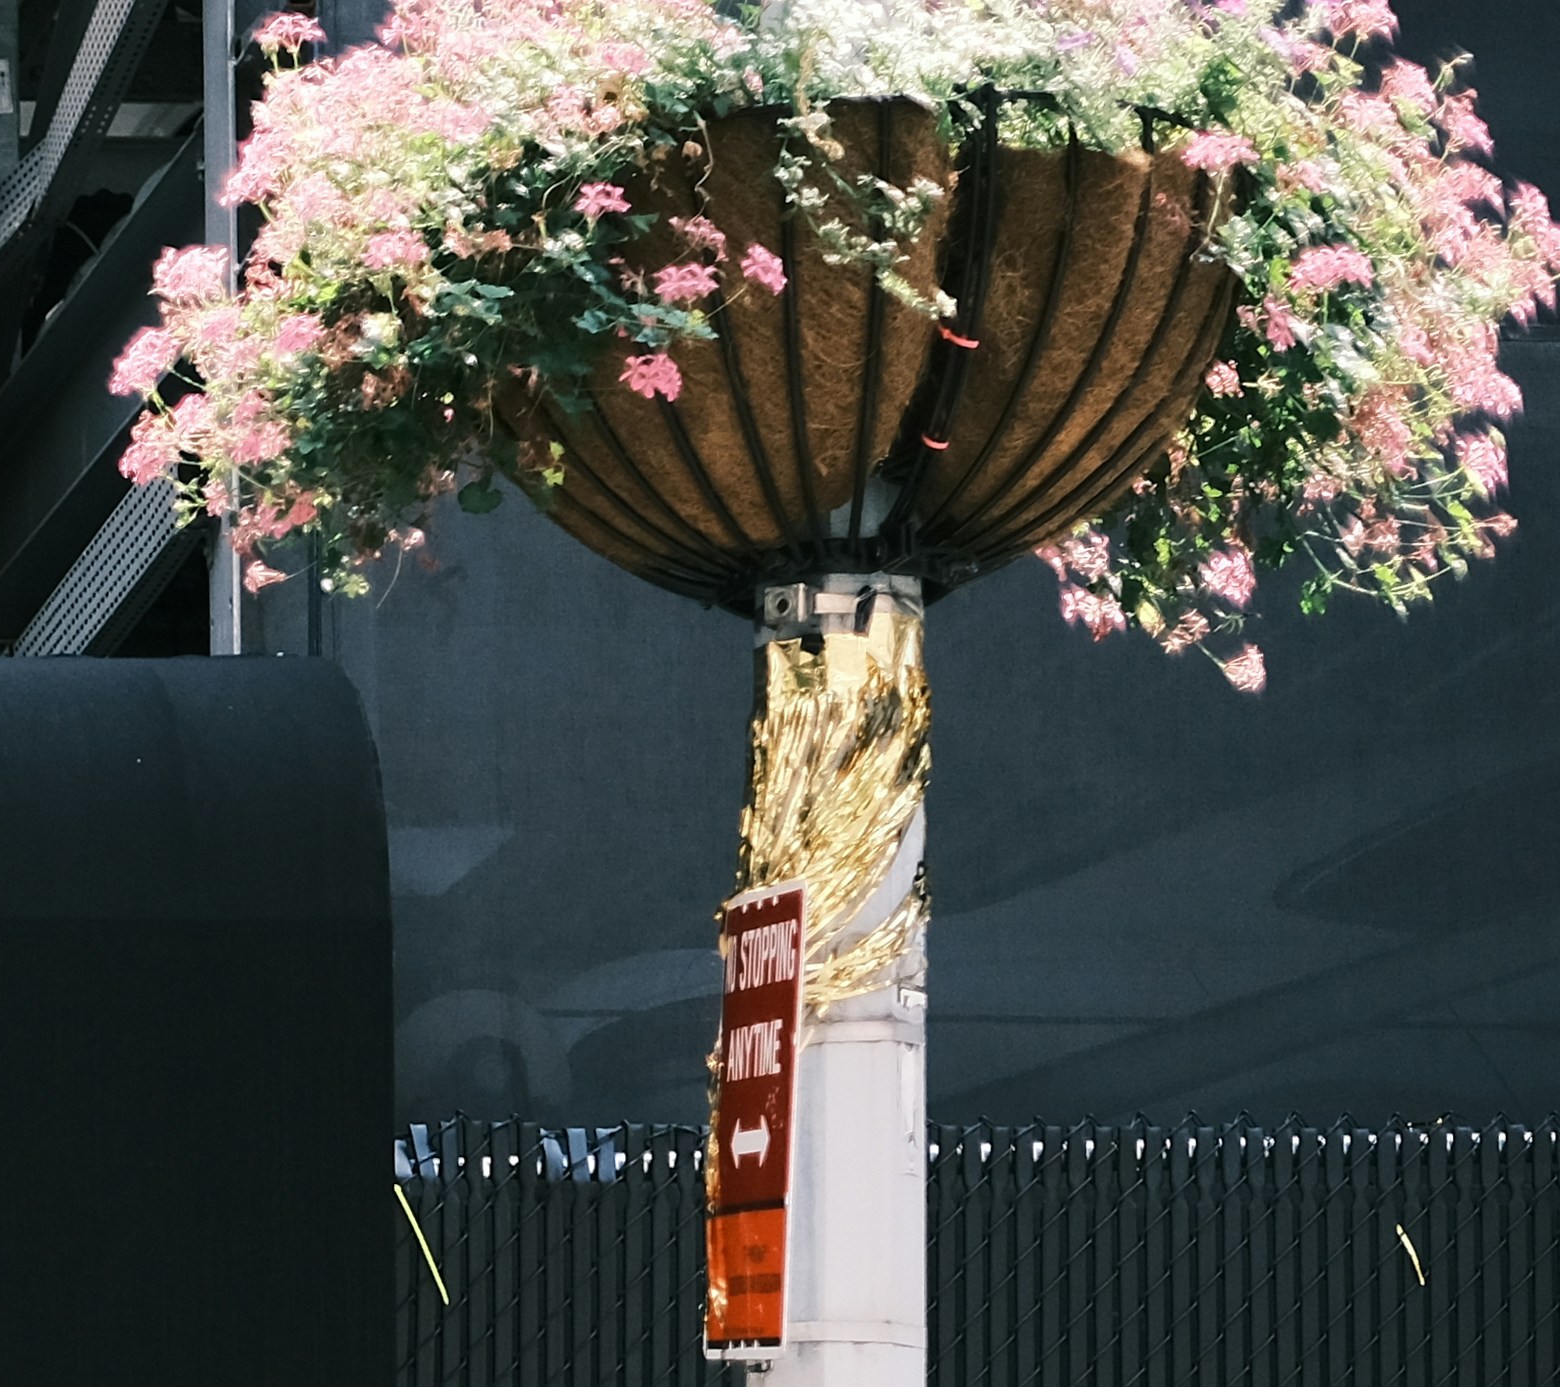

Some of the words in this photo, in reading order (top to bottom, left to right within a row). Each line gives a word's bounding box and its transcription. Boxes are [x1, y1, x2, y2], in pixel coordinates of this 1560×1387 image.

[725, 935, 738, 994] NO
[739, 918, 799, 992] STOPPING
[725, 1018, 784, 1083] ANYTIME
